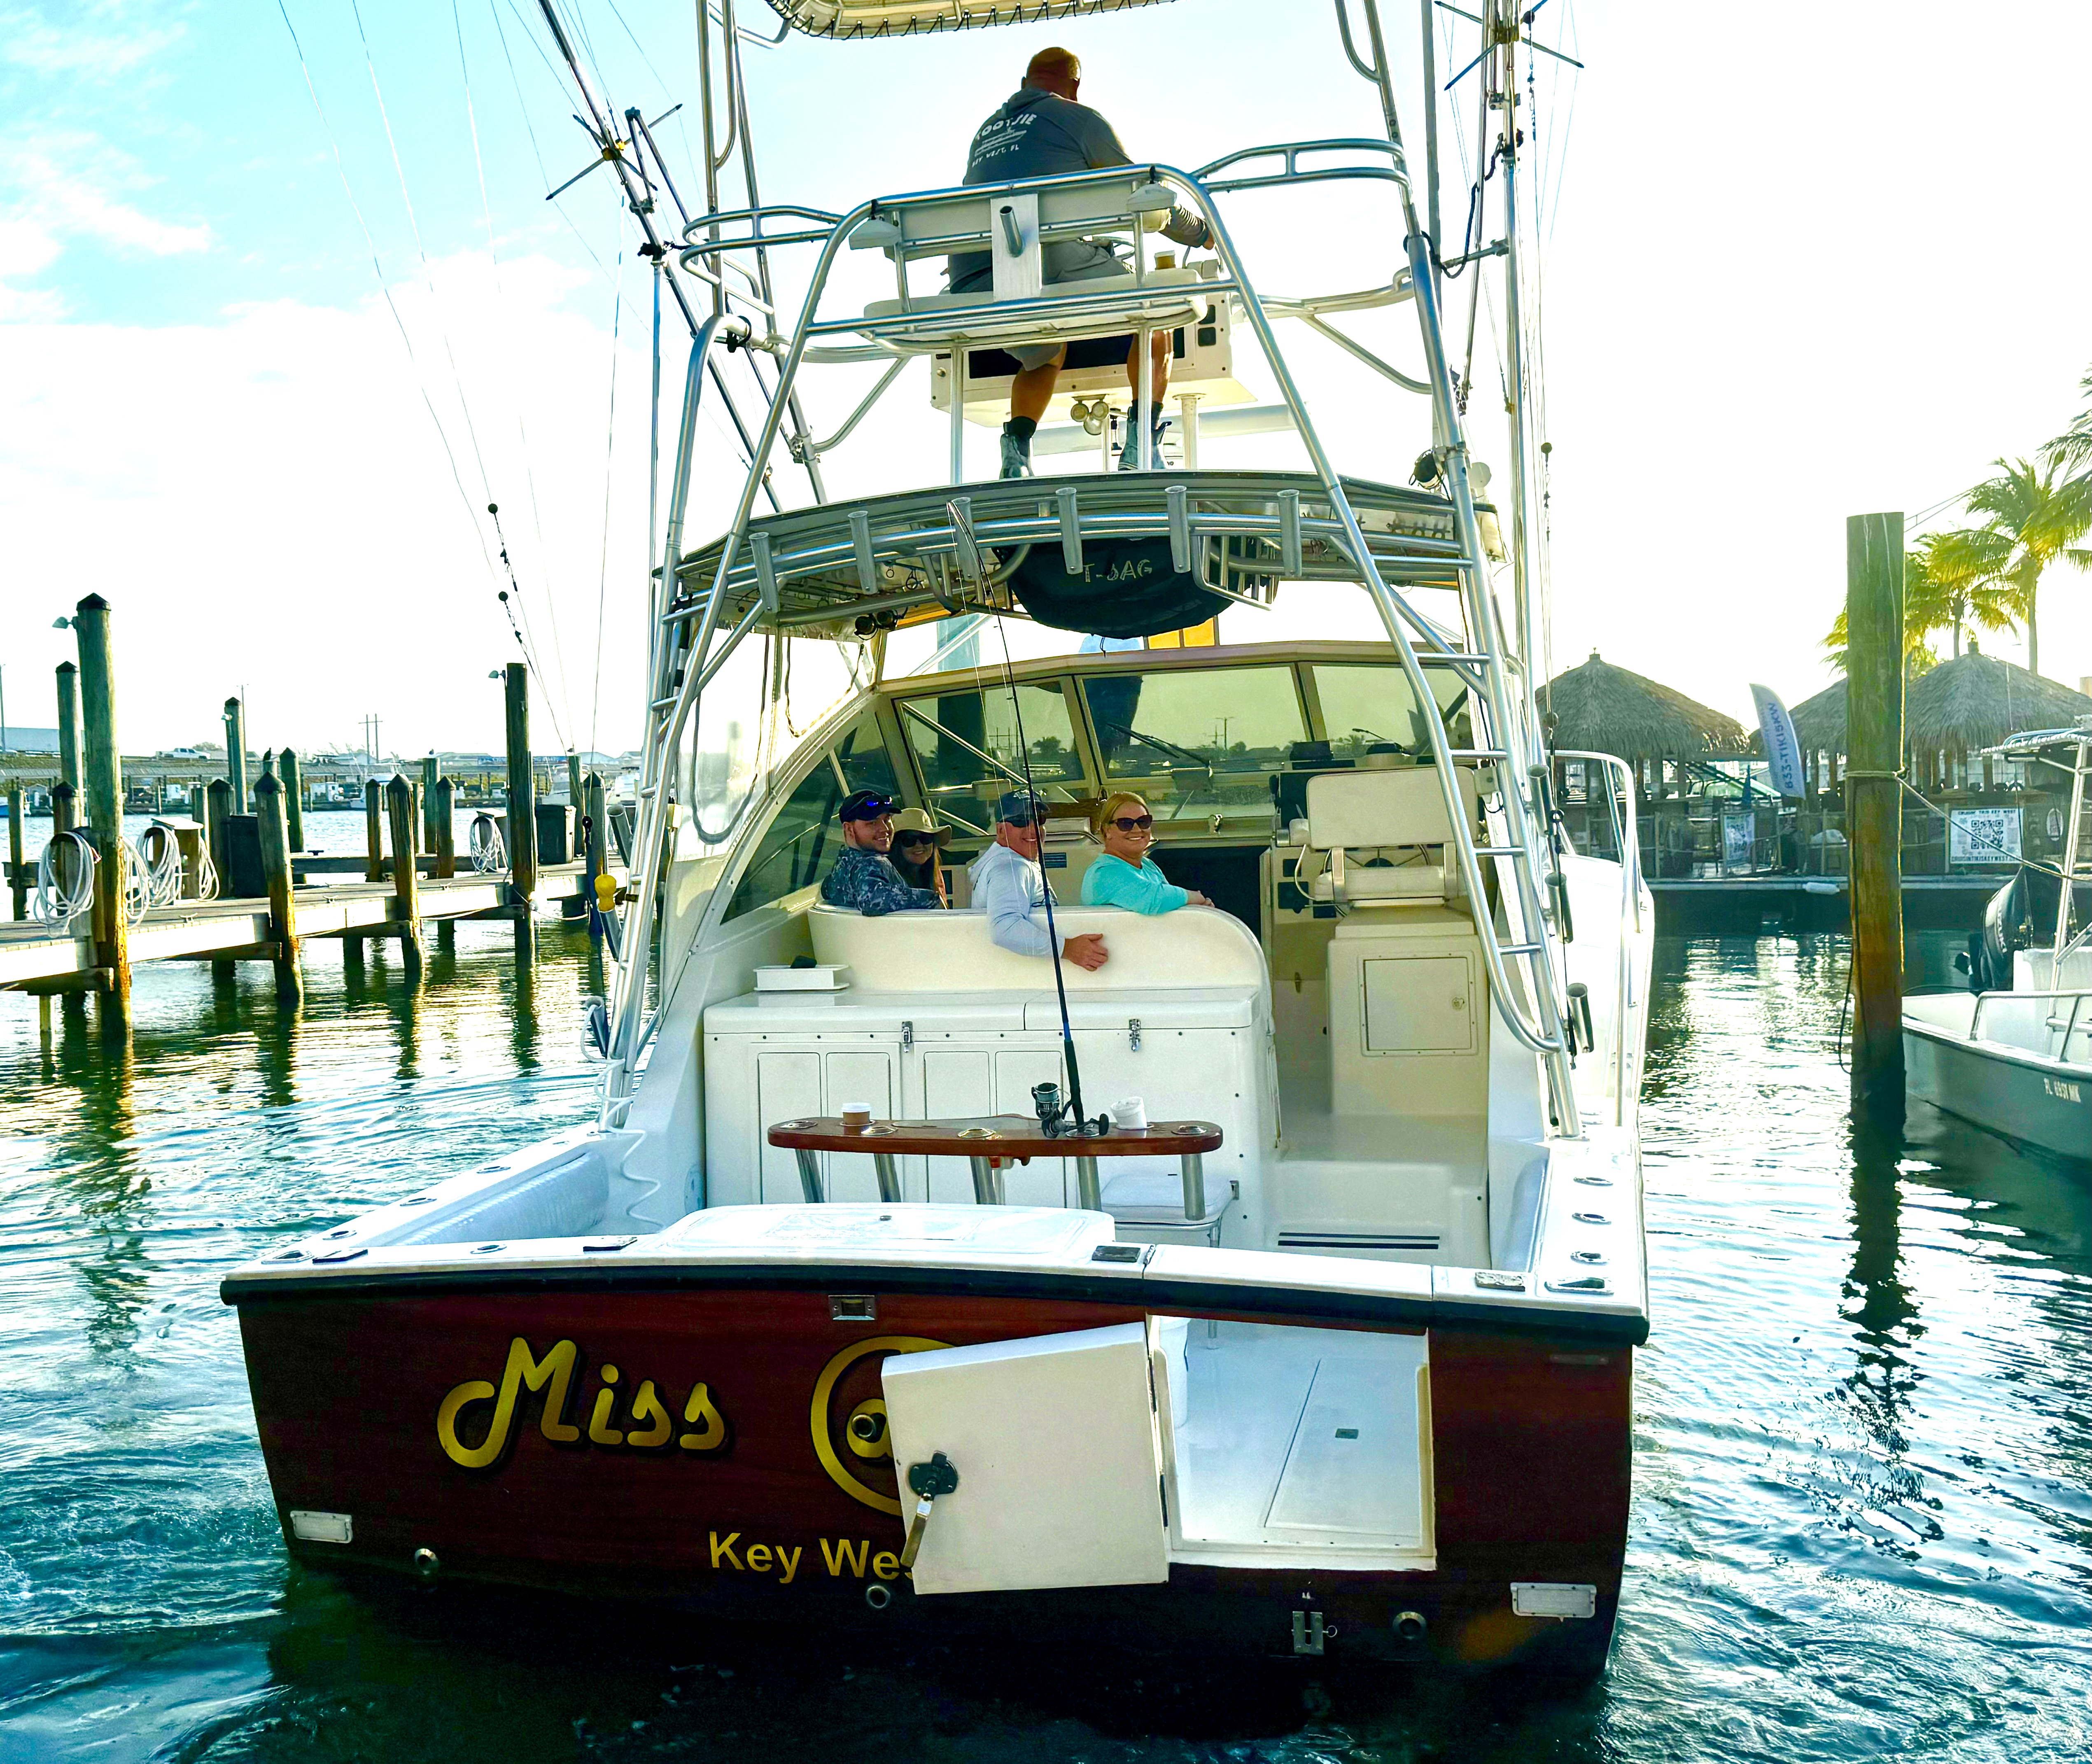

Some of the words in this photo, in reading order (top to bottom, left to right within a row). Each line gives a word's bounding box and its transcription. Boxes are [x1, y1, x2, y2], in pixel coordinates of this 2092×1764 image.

[436, 1337, 725, 1468] Miss
[709, 1531, 802, 1584] Key
[819, 1538, 913, 1580] We
